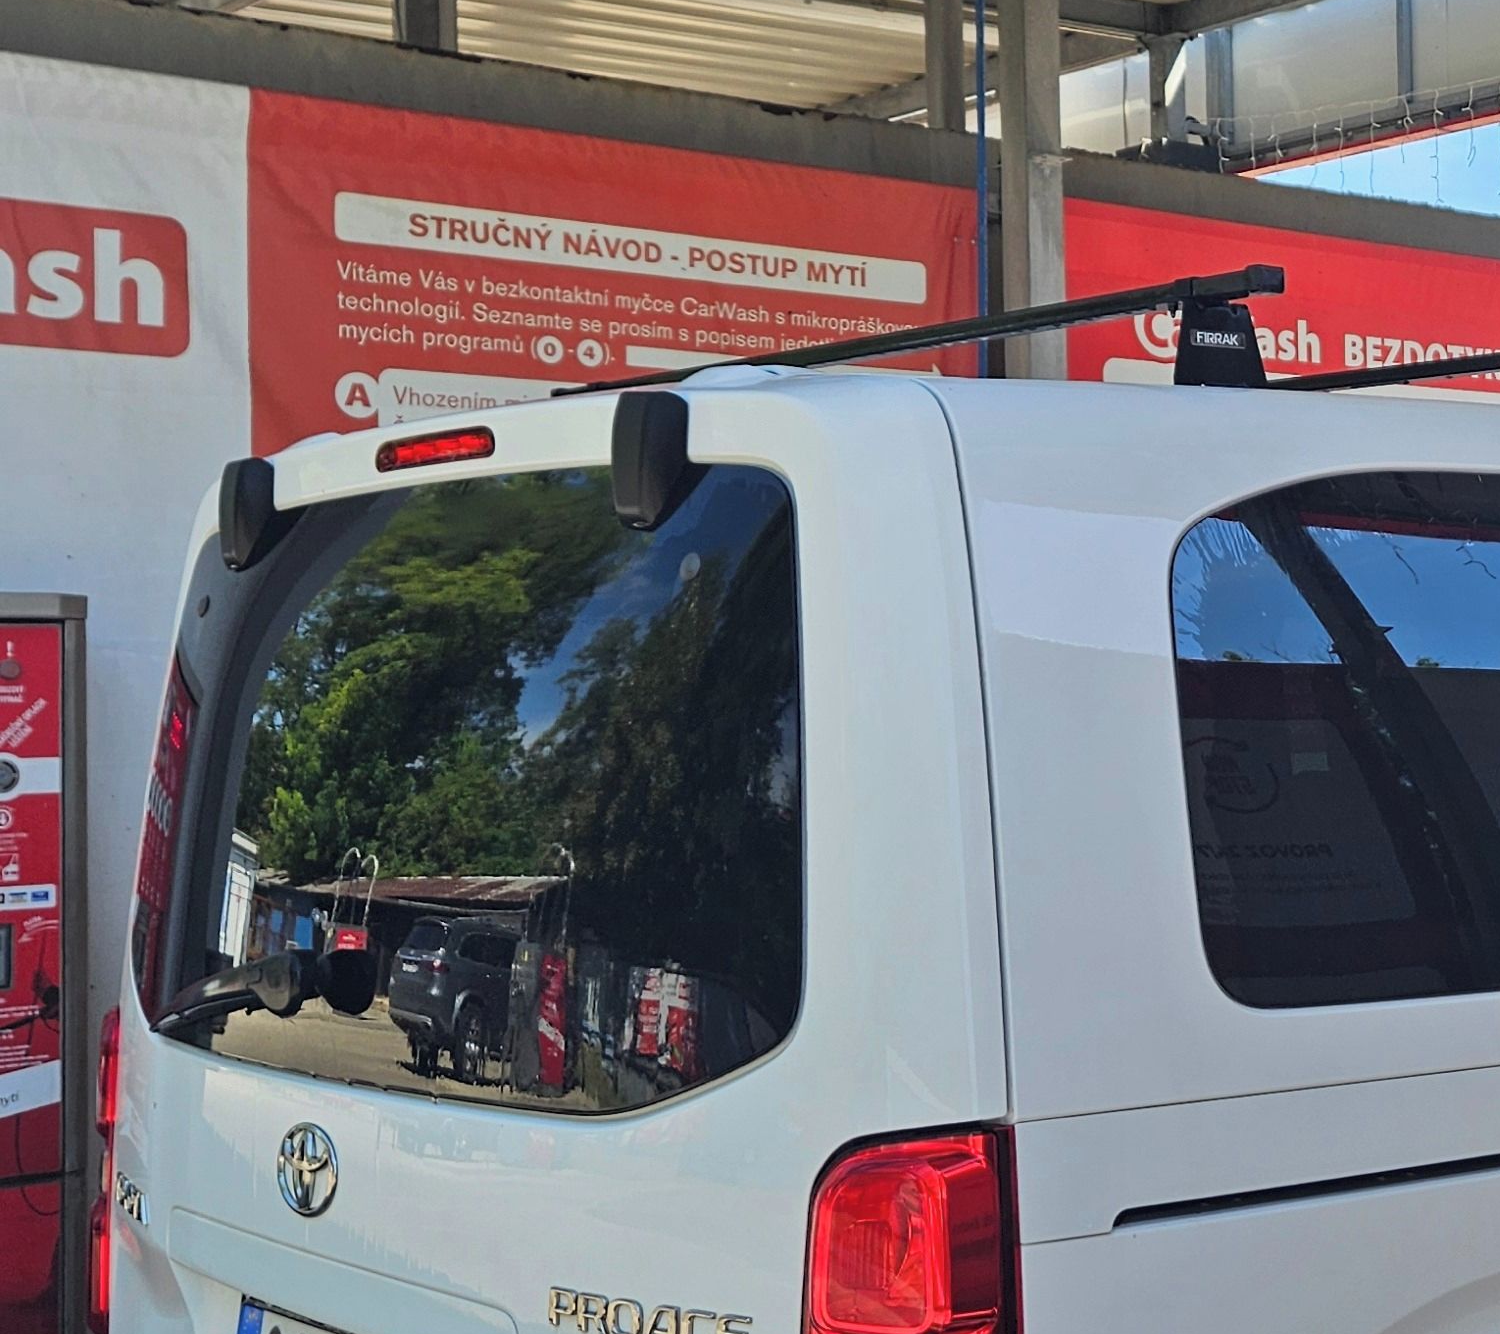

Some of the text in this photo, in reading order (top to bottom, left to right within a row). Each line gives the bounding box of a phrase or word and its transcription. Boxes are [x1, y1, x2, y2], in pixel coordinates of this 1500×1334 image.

[408, 213, 552, 251] STRUČNÝ
[563, 229, 662, 263] NÁVOD
[688, 247, 798, 279] POSTUP
[807, 261, 868, 287] MYTÍ
[336, 259, 411, 286] Vítáme
[419, 268, 458, 292] Vás
[465, 280, 475, 293] v
[482, 275, 609, 307] bezkontaktní
[615, 292, 675, 315] myčce
[681, 297, 769, 324] CarWash
[775, 311, 786, 325] s
[337, 291, 465, 322] technologií.
[472, 303, 572, 331] Seznamte
[579, 319, 602, 333] se
[608, 321, 673, 341] prosím
[678, 328, 688, 342] s
[695, 328, 774, 350] popisem
[338, 322, 415, 345] mycích
[423, 331, 523, 354] programů
[1196, 330, 1239, 346] FIRRAK
[345, 383, 371, 408] A
